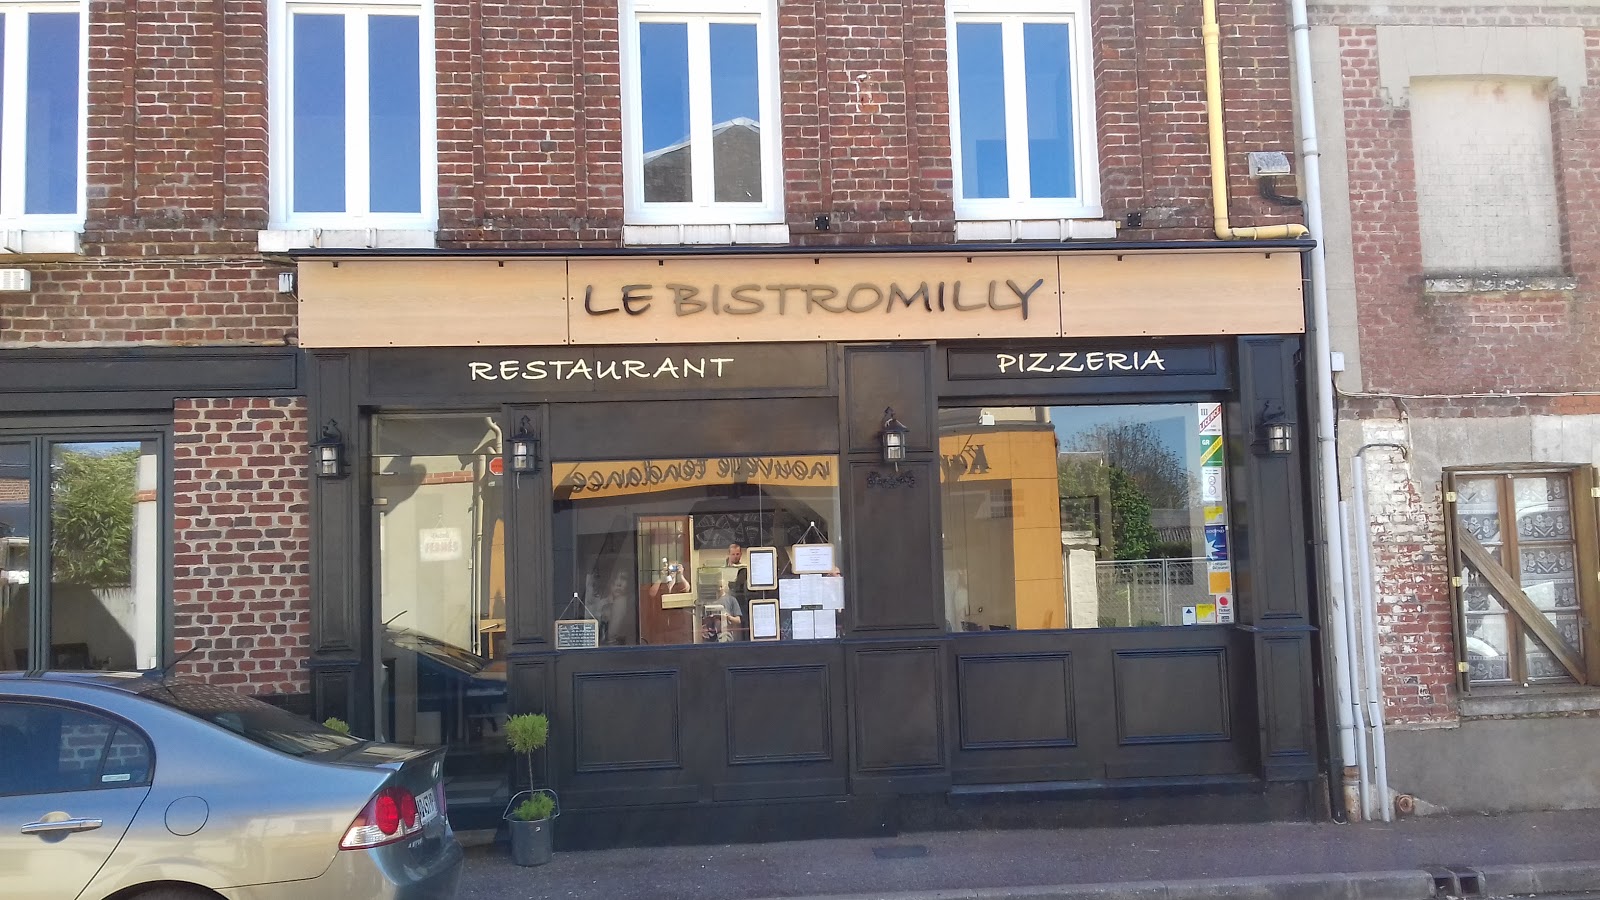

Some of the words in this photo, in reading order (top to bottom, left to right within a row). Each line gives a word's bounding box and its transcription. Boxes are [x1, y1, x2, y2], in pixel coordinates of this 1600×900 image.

[584, 283, 652, 316] LE
[666, 278, 1044, 320] BISTROMILLY
[468, 357, 735, 380] RESTAURANT
[996, 350, 1166, 373] PIZZERIA
